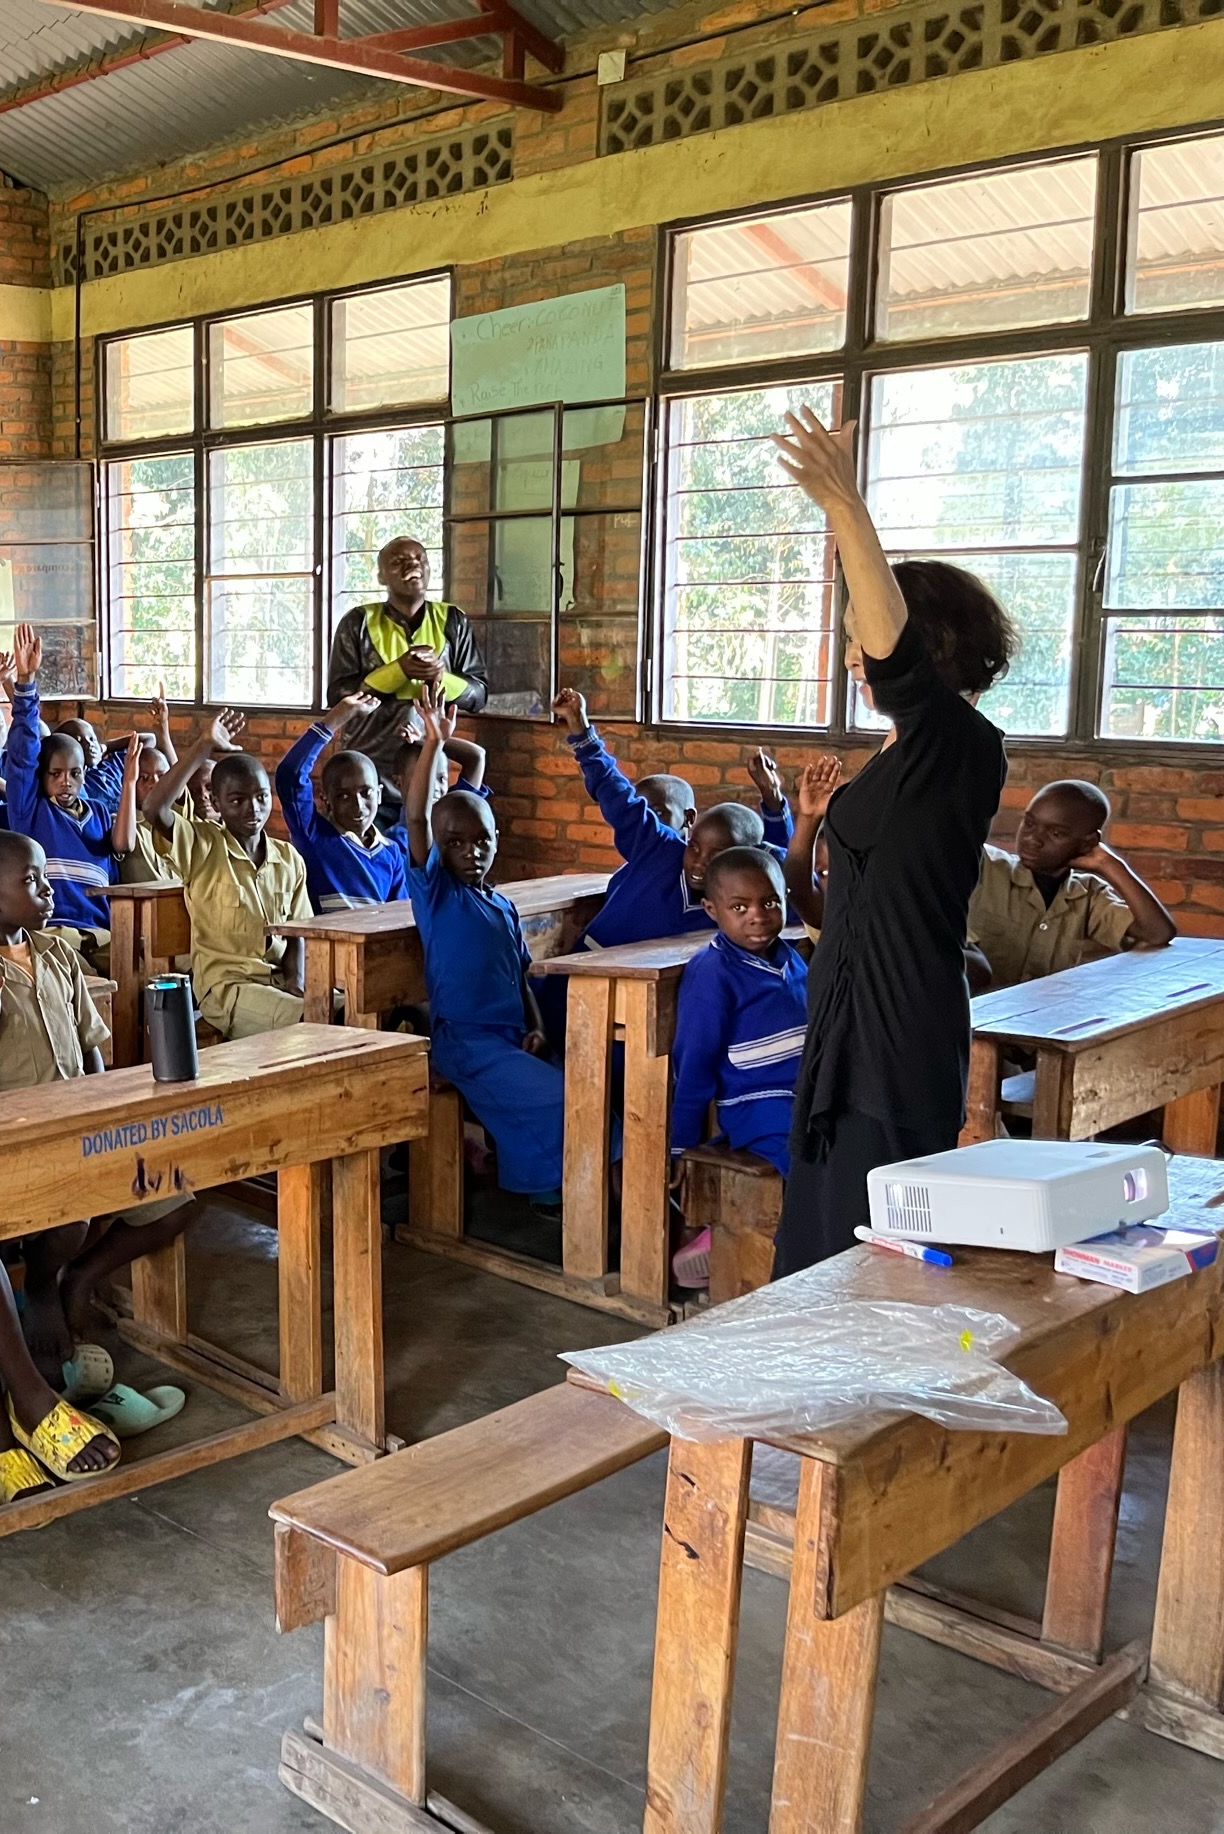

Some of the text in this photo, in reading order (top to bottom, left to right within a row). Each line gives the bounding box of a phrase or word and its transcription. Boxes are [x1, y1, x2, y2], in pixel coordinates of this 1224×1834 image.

[535, 297, 614, 327] COCONUT
[470, 381, 507, 405] Raise
[82, 1104, 224, 1157] DONATED BY SACOLA
